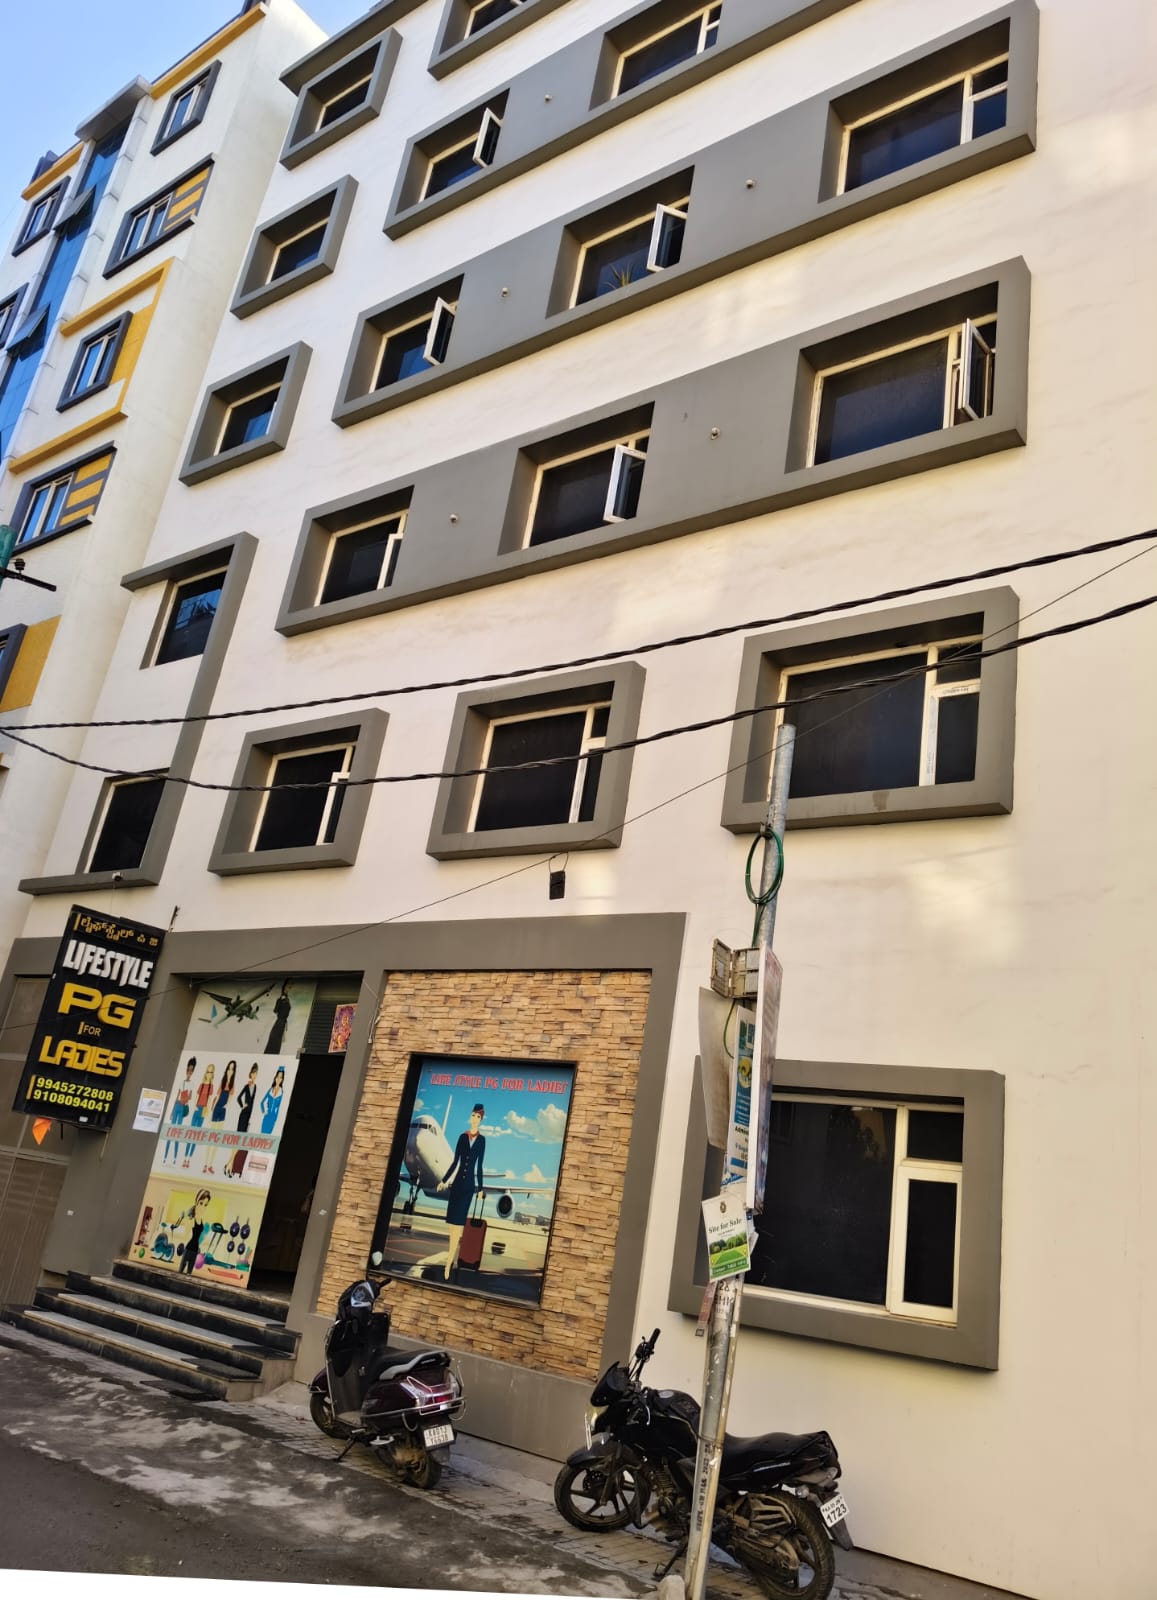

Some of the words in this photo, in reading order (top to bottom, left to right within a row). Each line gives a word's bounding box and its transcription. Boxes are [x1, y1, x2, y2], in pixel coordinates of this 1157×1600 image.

[62, 939, 153, 990] LIFESTYLE
[57, 982, 137, 1029] PG
[83, 1024, 102, 1037] FOR
[39, 1035, 126, 1078] LADIES
[36, 1077, 114, 1101] 9945272808
[430, 1073, 452, 1085] LIFE
[453, 1075, 481, 1088] STYLE
[484, 1077, 498, 1090] PG
[501, 1077, 523, 1091] FOR
[527, 1078, 568, 1094] LADIES
[33, 1089, 110, 1113] 9108094041
[166, 1127, 183, 1139] LIFE
[184, 1129, 207, 1141] STYLE
[207, 1131, 220, 1144] PG
[221, 1133, 240, 1145] FOR
[242, 1135, 275, 1150] LADIES
[708, 1223, 719, 1234] Site
[720, 1221, 729, 1230] for
[729, 1218, 742, 1227] Sale
[826, 1503, 847, 1523] 1723
